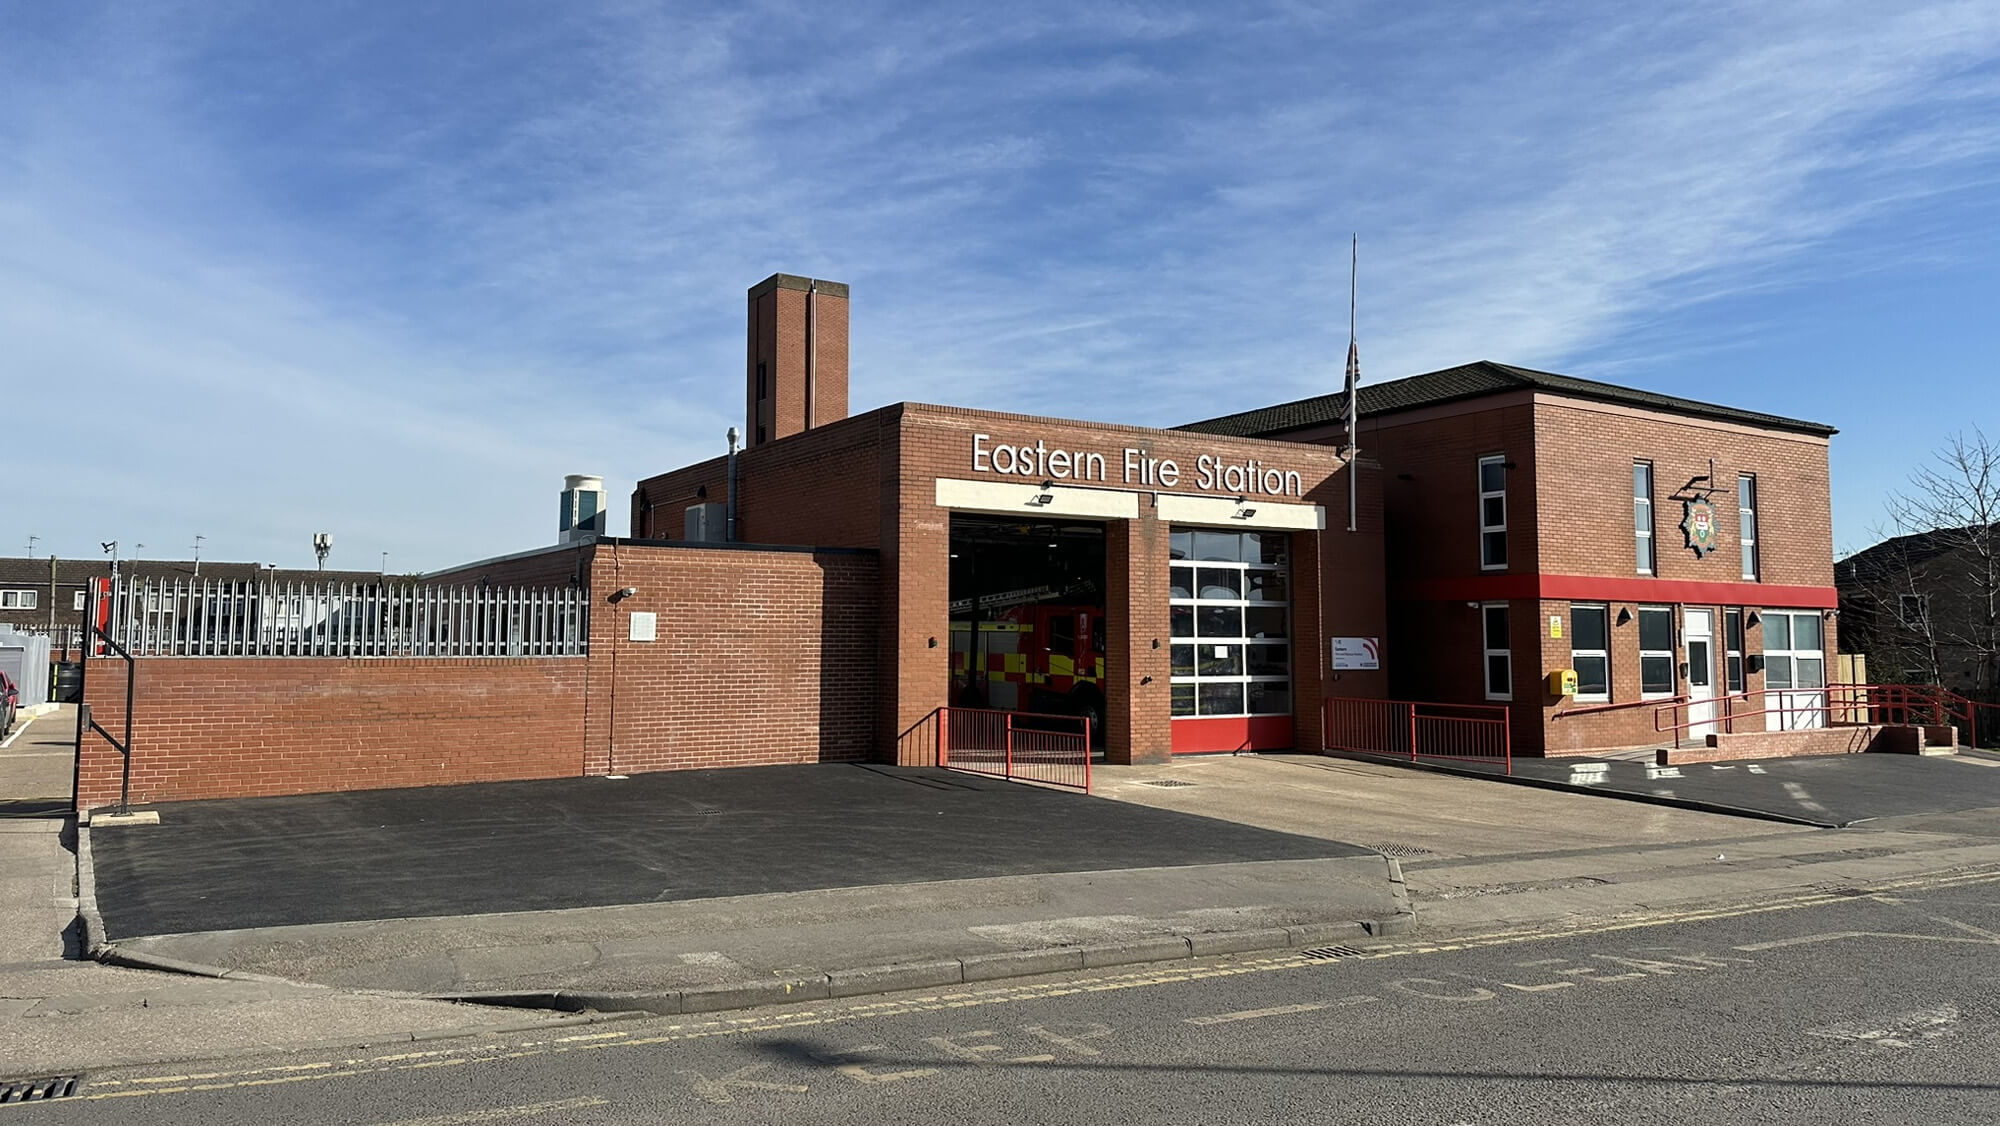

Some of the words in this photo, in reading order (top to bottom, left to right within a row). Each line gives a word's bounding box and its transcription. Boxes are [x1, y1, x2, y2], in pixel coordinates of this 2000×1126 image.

[972, 433, 1106, 482] Eastern
[1123, 448, 1180, 487] Fire
[1196, 454, 1301, 496] Station
